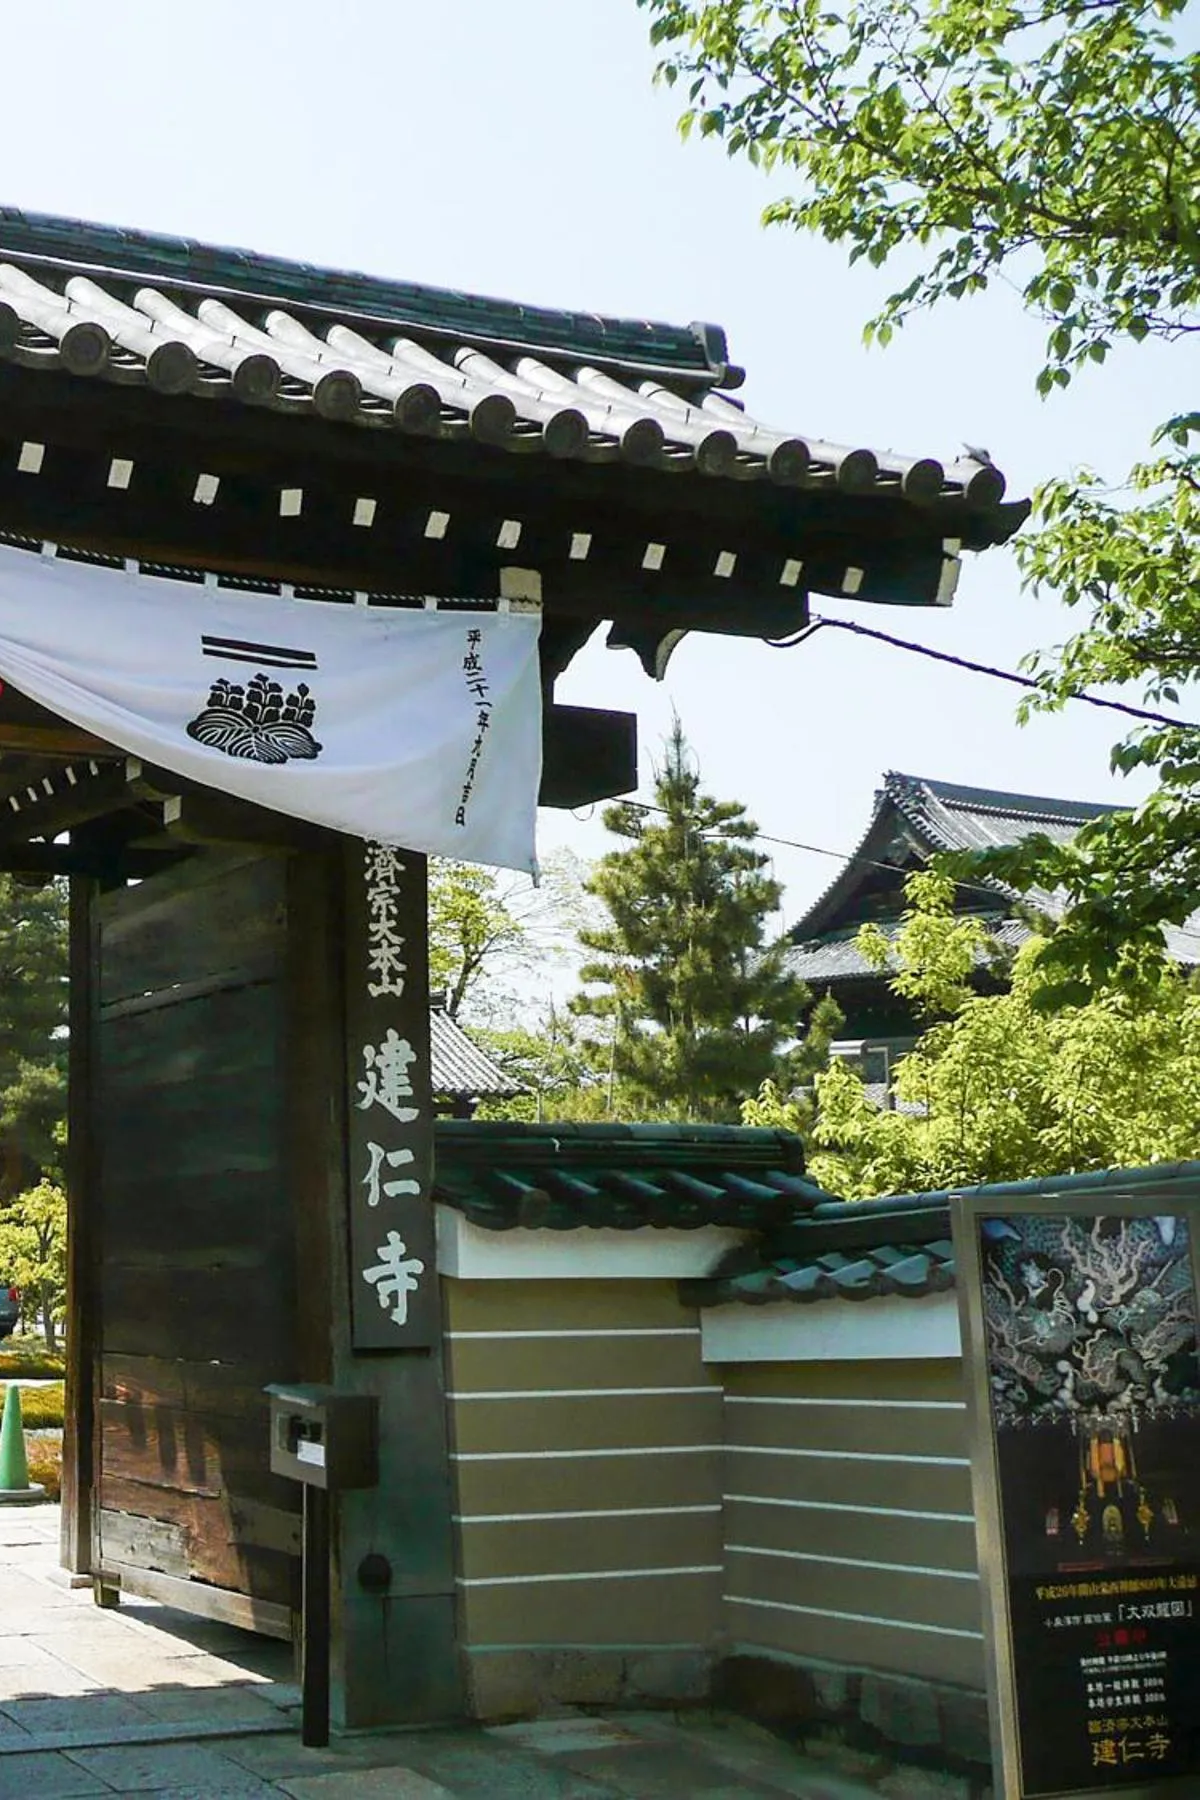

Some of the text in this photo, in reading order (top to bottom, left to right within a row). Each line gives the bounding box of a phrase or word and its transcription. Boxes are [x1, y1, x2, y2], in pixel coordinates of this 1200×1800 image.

[355, 1028, 424, 1326] 建仁寺
[1091, 1732, 1171, 1767] 建仁寺
